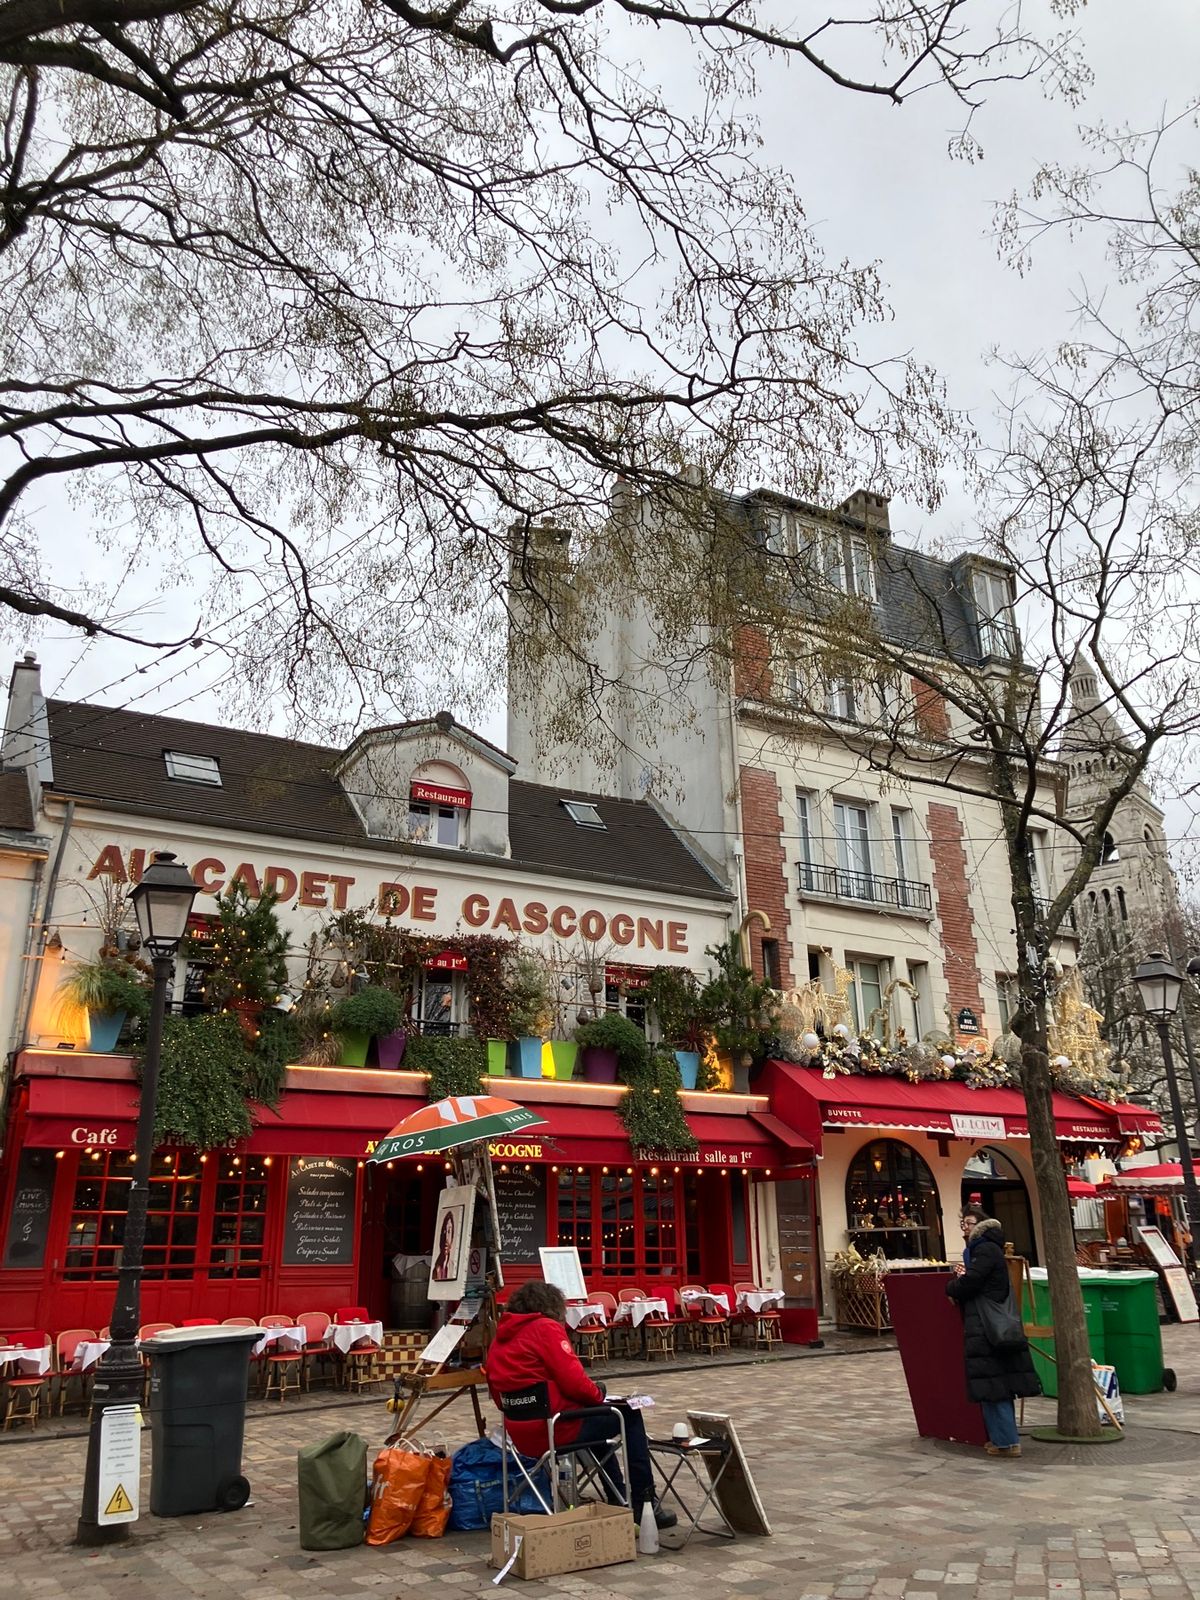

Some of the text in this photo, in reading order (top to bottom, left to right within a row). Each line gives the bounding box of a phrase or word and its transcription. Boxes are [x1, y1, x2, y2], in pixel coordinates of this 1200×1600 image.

[417, 788, 466, 805] Restaurant
[191, 858, 355, 910] CADET
[378, 882, 438, 922] DE
[462, 893, 688, 953] GASCOGNE
[437, 959, 447, 967] au
[505, 1112, 533, 1124] PARIS
[827, 1109, 862, 1118] BUVETTE
[1072, 1125, 1111, 1133] RESTAURANT
[71, 1127, 117, 1145] Café
[704, 1150, 727, 1163] salle
[728, 1154, 738, 1163] au
[740, 1151, 753, 1164] 1er
